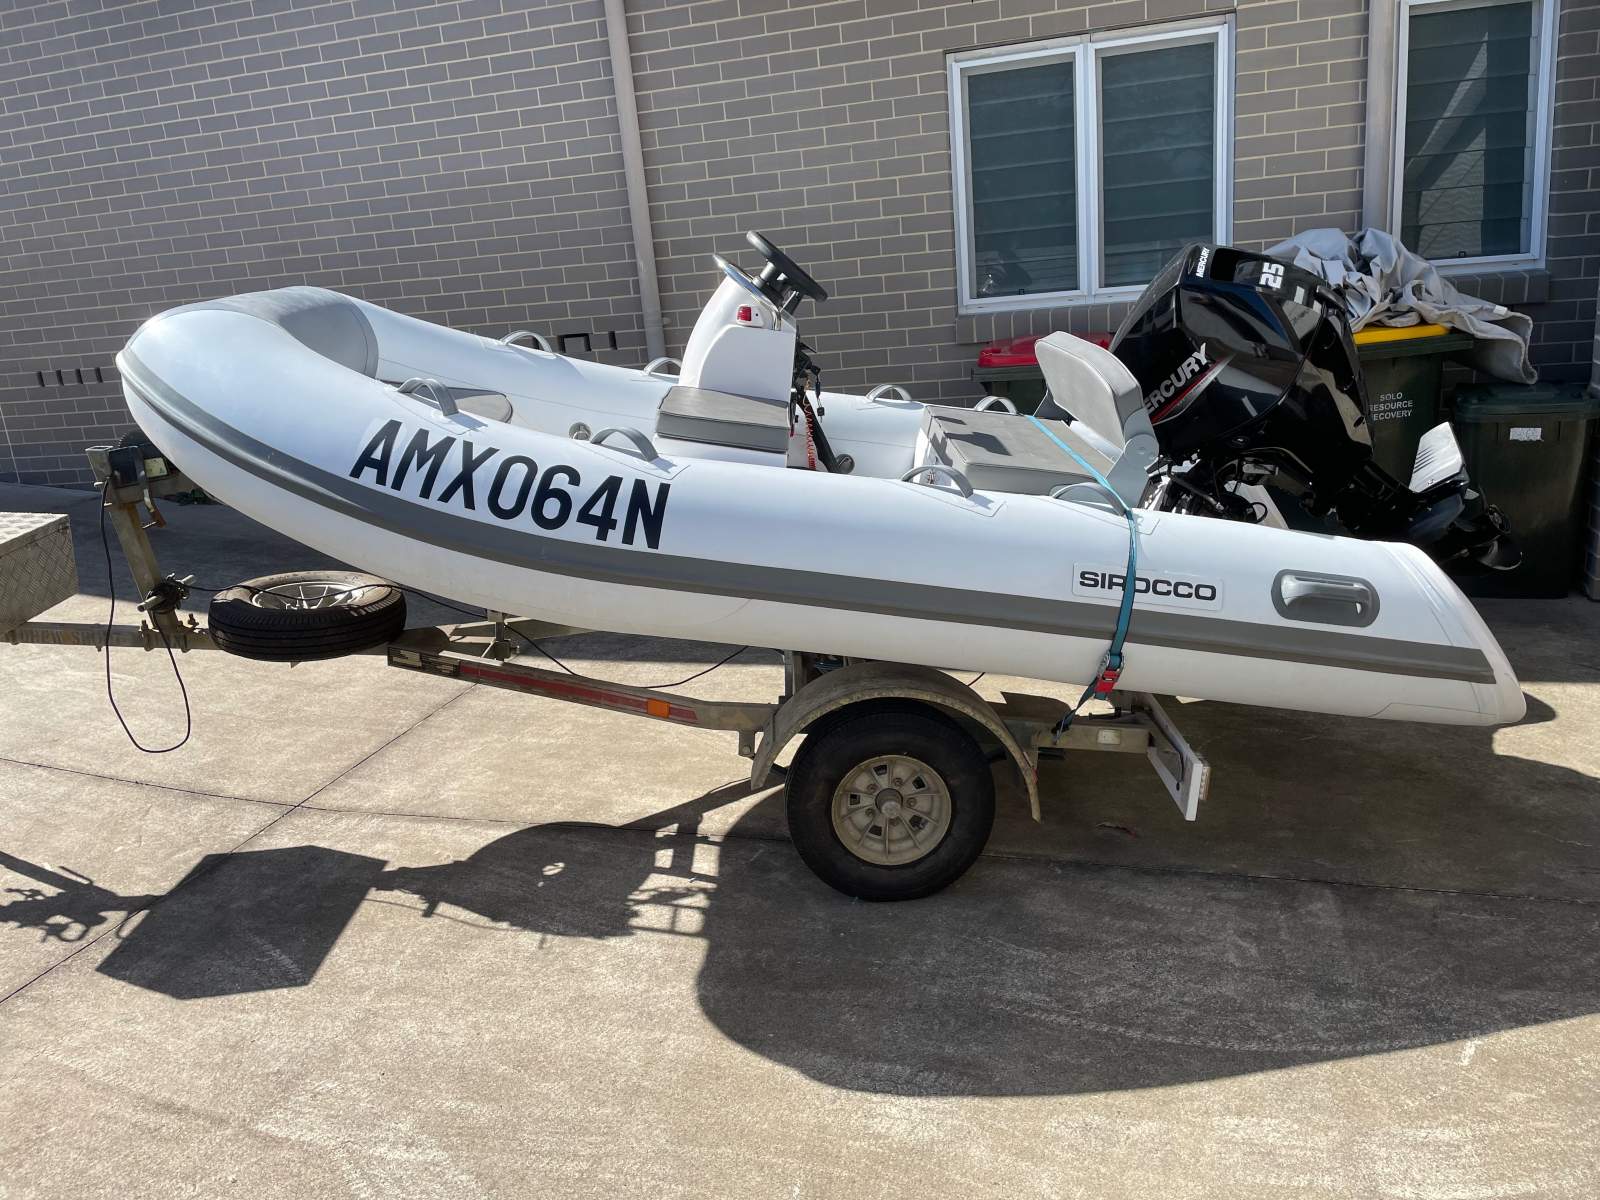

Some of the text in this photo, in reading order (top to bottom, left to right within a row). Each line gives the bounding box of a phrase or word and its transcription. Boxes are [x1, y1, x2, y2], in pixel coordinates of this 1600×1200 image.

[1196, 246, 1210, 278] MERCURY
[1259, 262, 1285, 289] 25
[1143, 342, 1207, 414] ERCURY
[1380, 392, 1403, 401] SOLO
[1373, 410, 1412, 421] ECOVERY
[348, 419, 671, 550] AMX064N
[1079, 570, 1217, 601] SIROCCO
